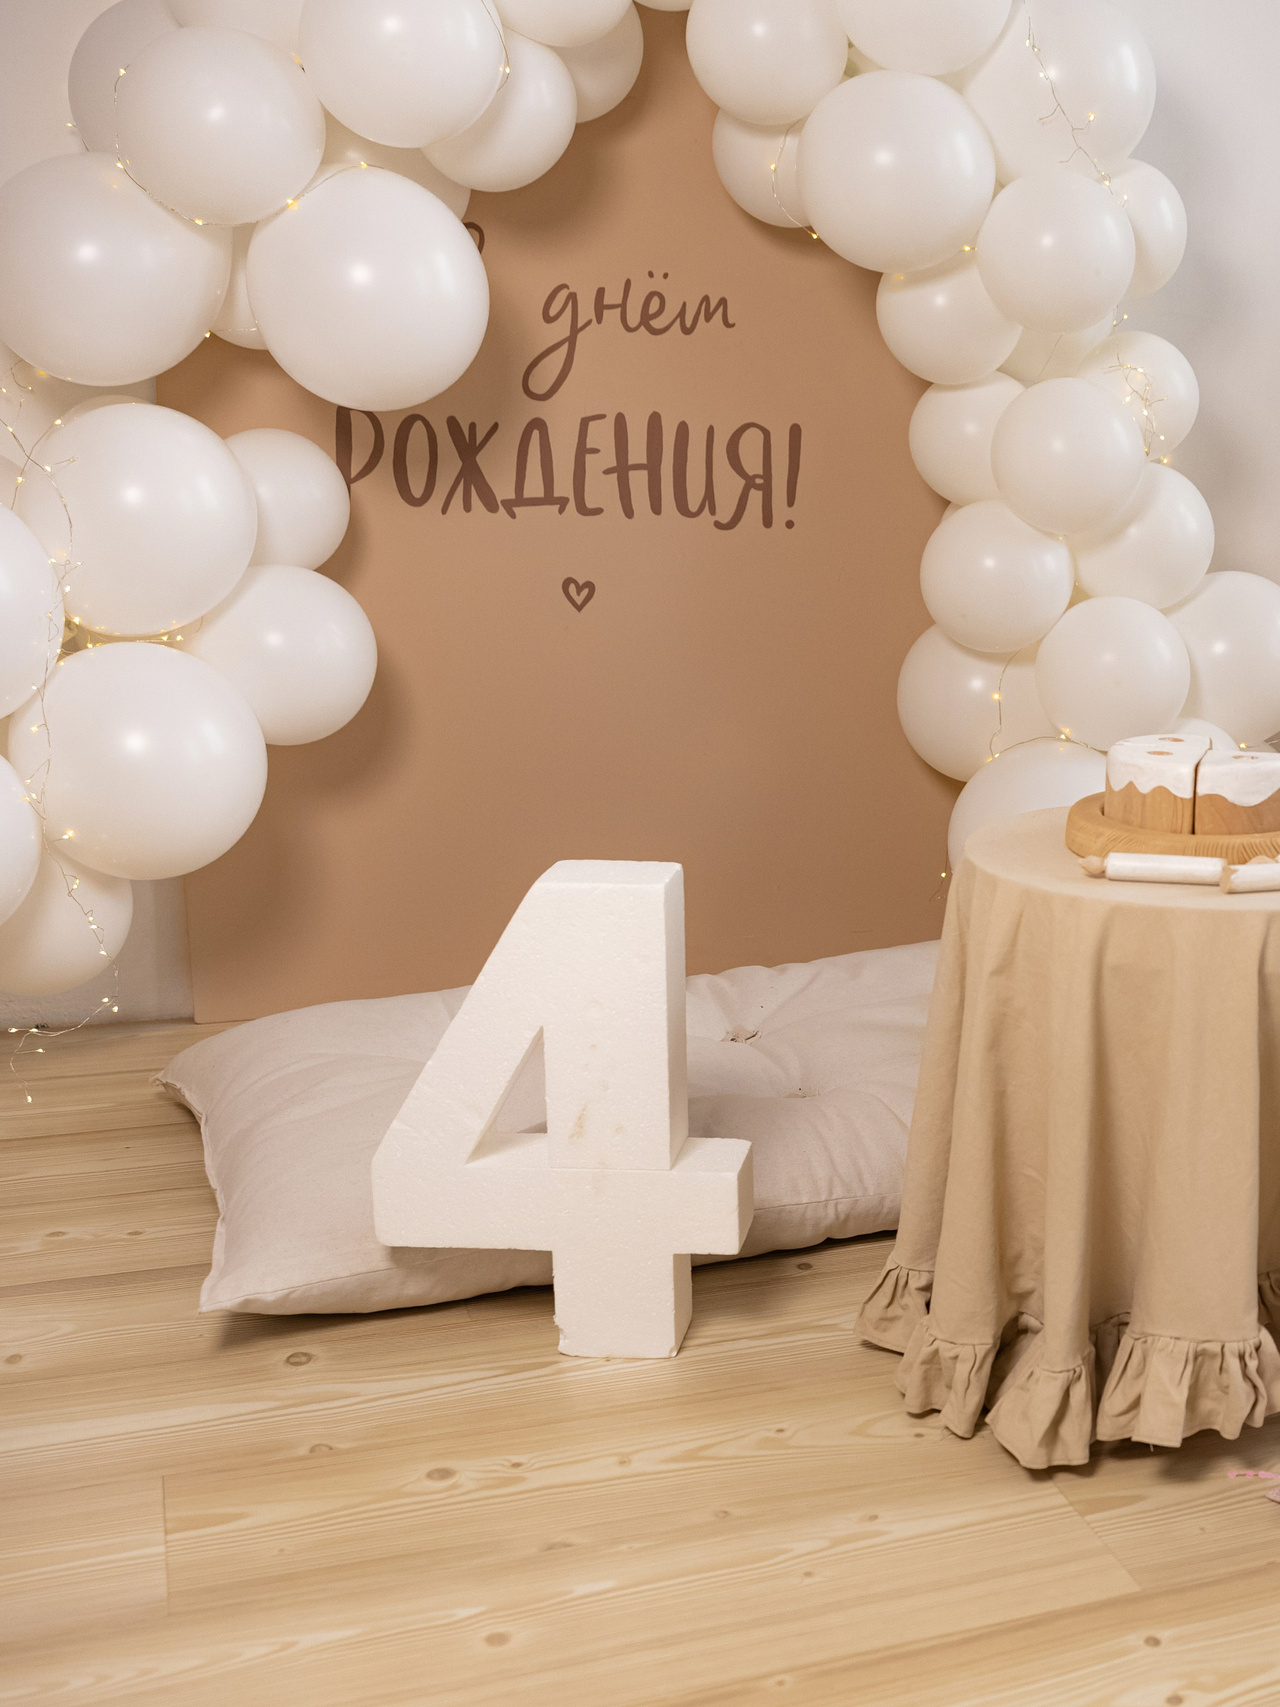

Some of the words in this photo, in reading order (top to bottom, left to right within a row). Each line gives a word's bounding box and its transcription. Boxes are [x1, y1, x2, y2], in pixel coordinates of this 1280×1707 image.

[522, 270, 736, 401] днём
[335, 406, 802, 531] РОЖДЕНИЯ!
[372, 859, 754, 1359] 4
